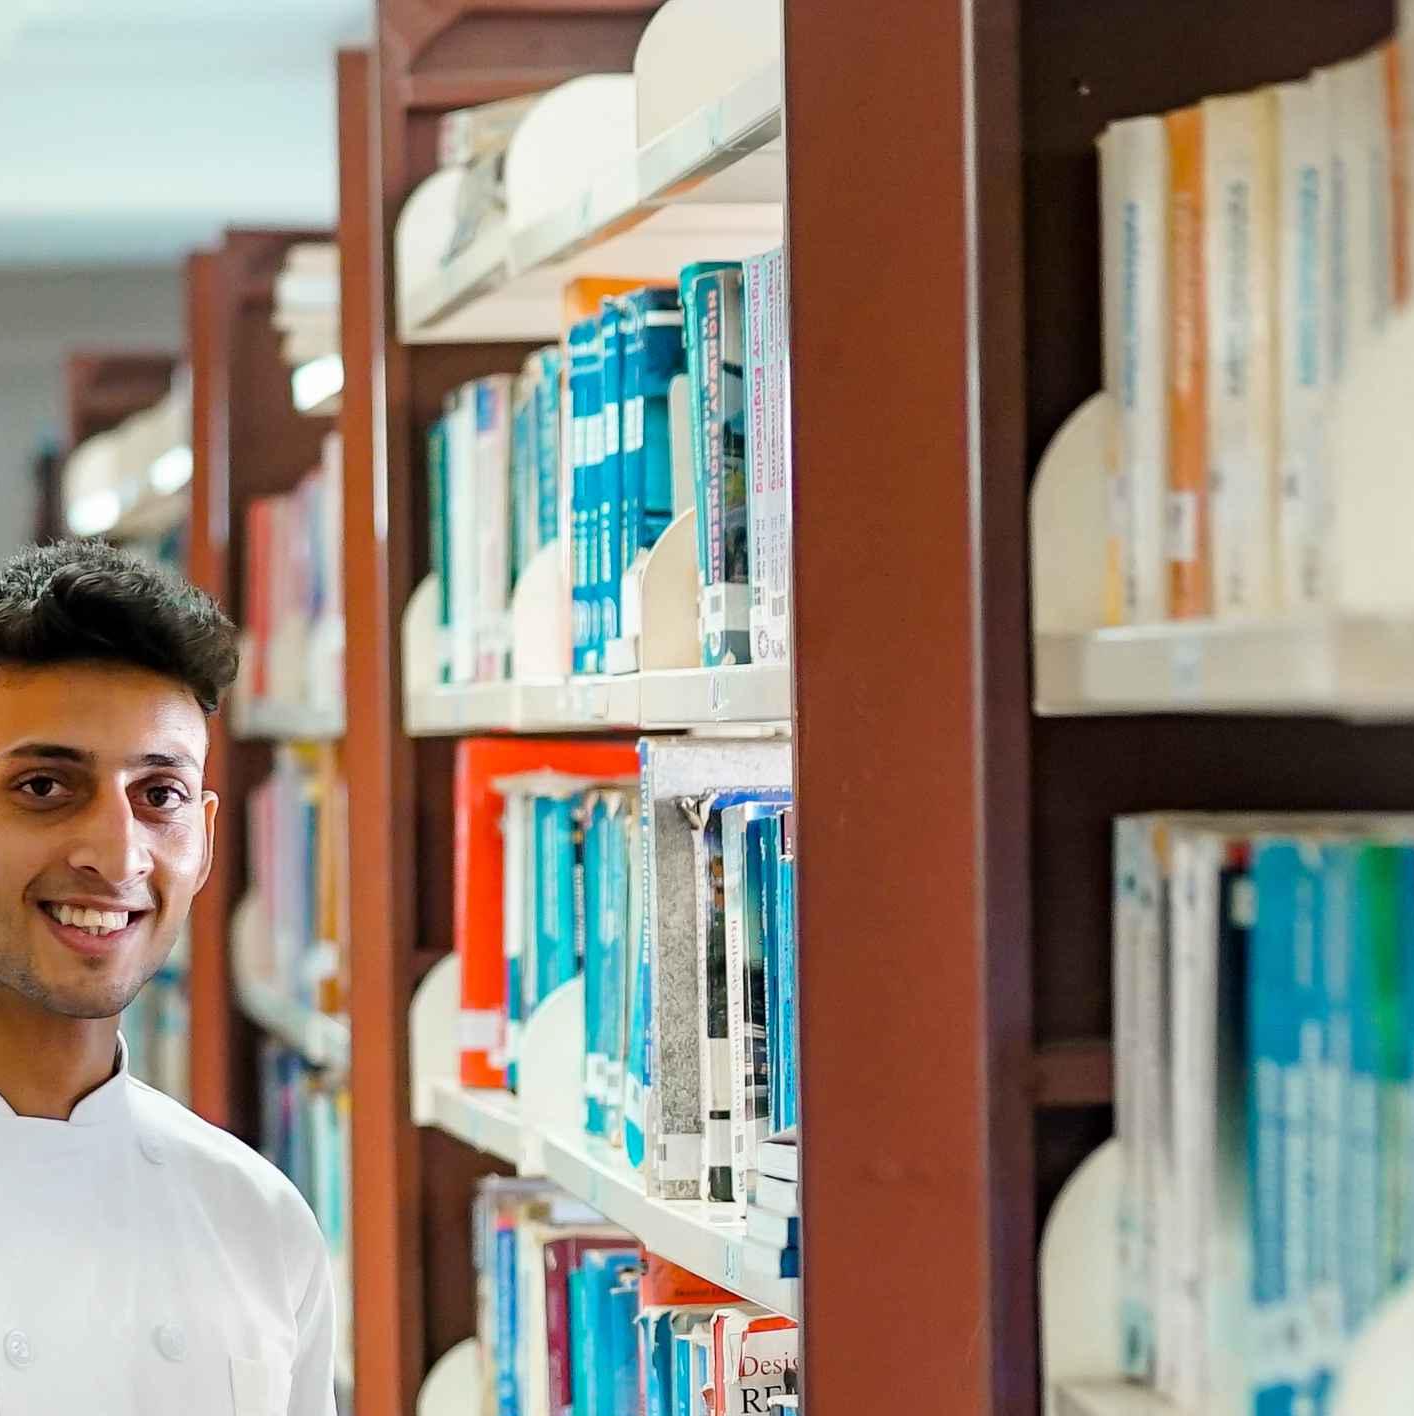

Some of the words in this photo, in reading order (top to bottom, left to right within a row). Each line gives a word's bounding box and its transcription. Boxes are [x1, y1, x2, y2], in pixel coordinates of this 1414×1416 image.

[751, 264, 763, 357] Highway
[753, 367, 765, 493] Engineering
[708, 421, 721, 584] ENGINEERIN
